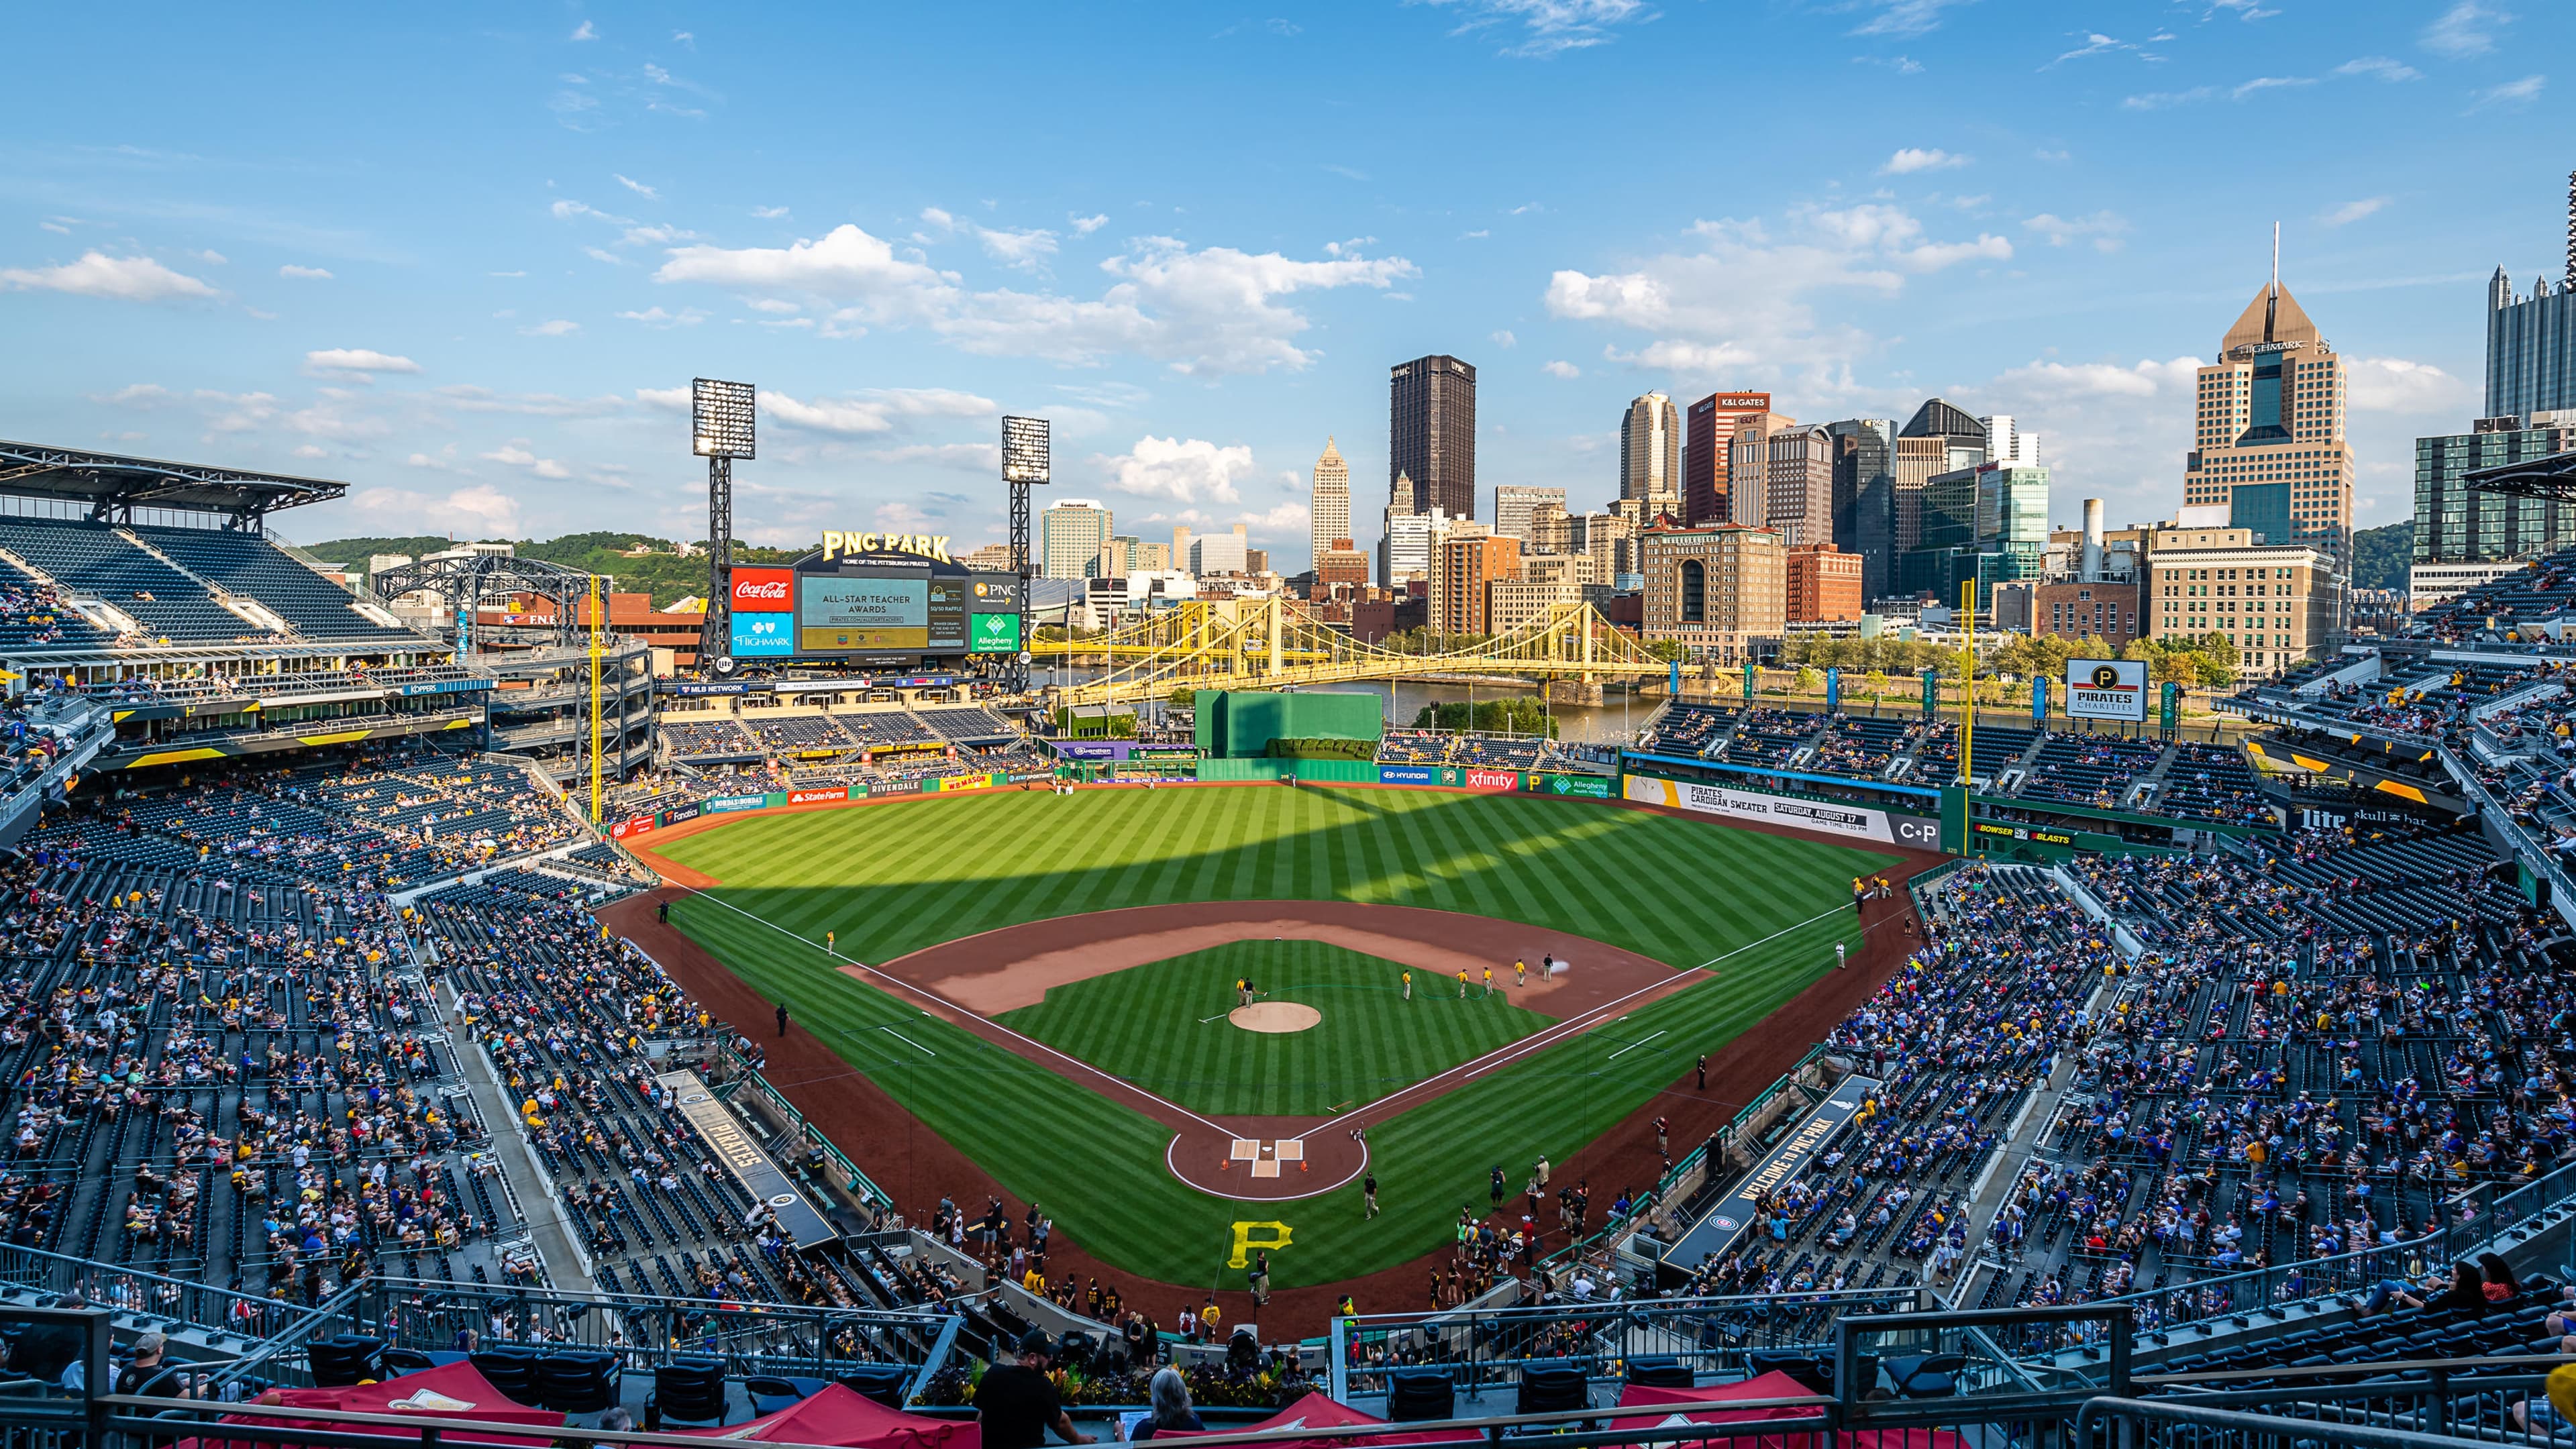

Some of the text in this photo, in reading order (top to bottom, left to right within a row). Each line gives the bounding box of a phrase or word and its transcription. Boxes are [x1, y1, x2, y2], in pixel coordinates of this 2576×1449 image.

[2240, 340, 2305, 354] HIGHMARK
[1391, 366, 1410, 378] UPMC
[1451, 361, 1465, 374] UPMC
[1740, 415, 1759, 423] EQT
[823, 529, 951, 565] PNC PARK
[736, 581, 788, 598] Coca-Cola
[989, 585, 1016, 596] PNC
[738, 637, 790, 646] HIGHMARK
[978, 637, 1013, 645] Allegheny
[719, 660, 731, 668] Lite
[2100, 671, 2112, 686] P
[411, 685, 436, 694] KOPPERS
[2077, 692, 2132, 704] PIRATES
[2077, 702, 2132, 712] CHARITIES
[1074, 747, 1111, 755] Guardian
[1470, 771, 1514, 789] xfinity
[1529, 775, 1541, 791] P
[1574, 781, 1607, 790] Allegheny
[872, 782, 919, 793] RIVENDALE
[1692, 786, 1722, 798] PIRATES
[1715, 783, 1755, 792] WELCOME
[739, 796, 762, 804] BORDAS
[1692, 795, 1767, 814] CARDIGAN SWEATER
[674, 808, 698, 822] Fanatics
[1775, 804, 1856, 823] SATURDAY, AUGUST 17
[2354, 810, 2427, 826] skull bar
[1980, 825, 2013, 836] BOWSER
[2037, 834, 2069, 844] BLASTS
[708, 1123, 763, 1168] PIRATES
[1739, 1118, 1835, 1201] WELCOME TO PNC PARK
[1227, 1220, 1293, 1269] P
